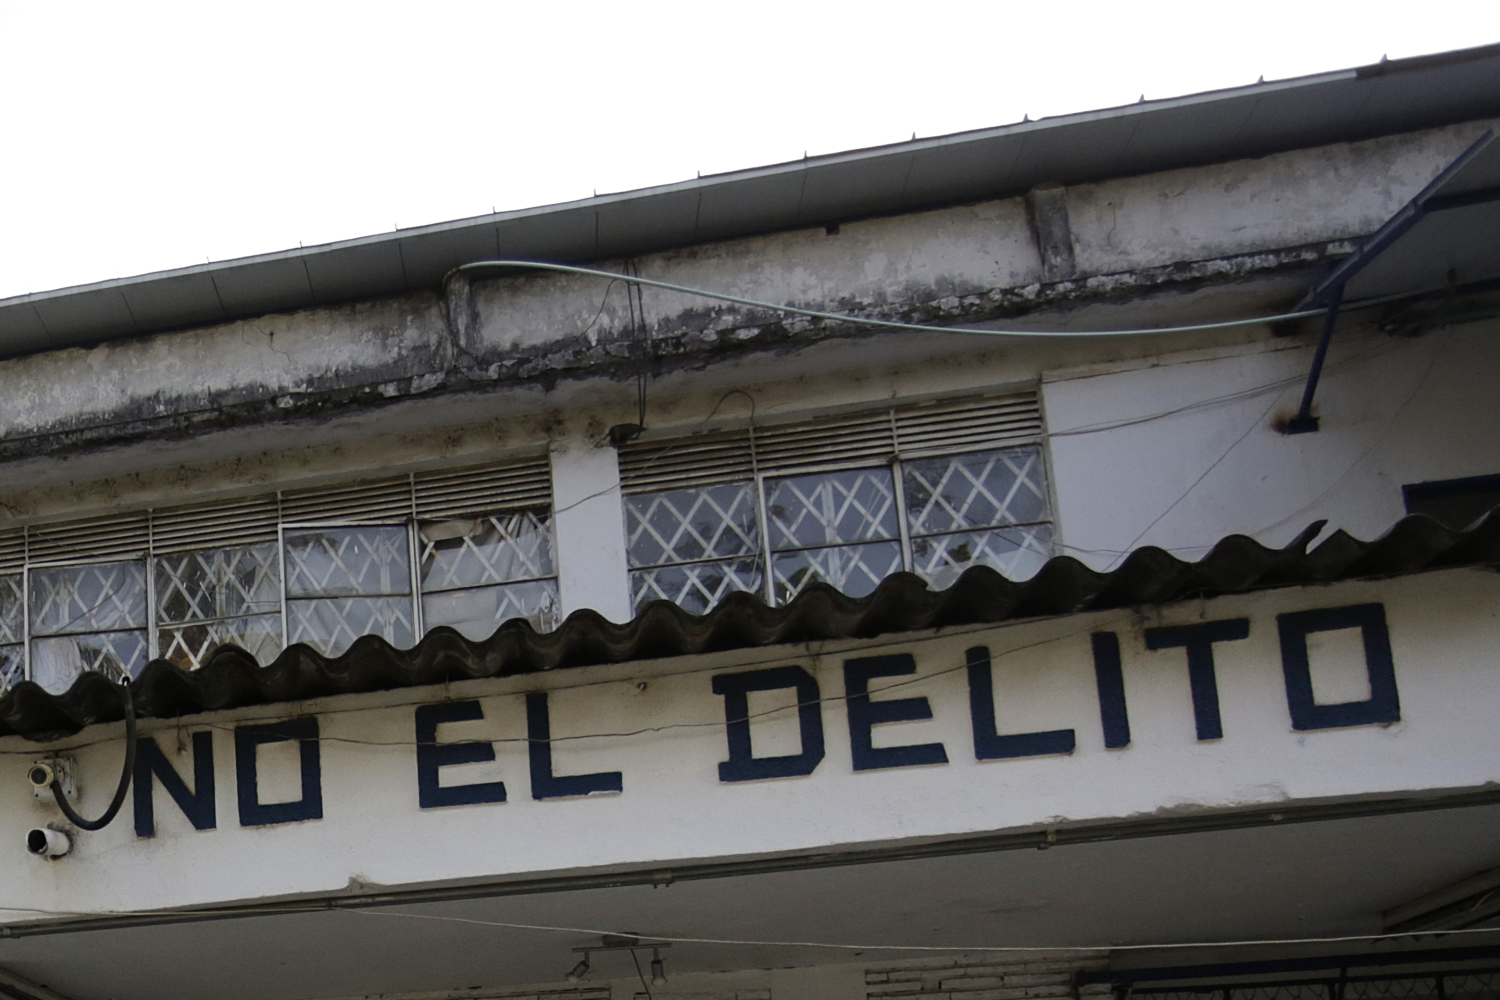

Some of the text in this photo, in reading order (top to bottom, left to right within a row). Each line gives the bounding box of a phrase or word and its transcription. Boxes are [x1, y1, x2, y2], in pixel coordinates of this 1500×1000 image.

[133, 714, 323, 837] NO
[415, 691, 623, 809] EL
[710, 602, 1402, 784] DELITO
